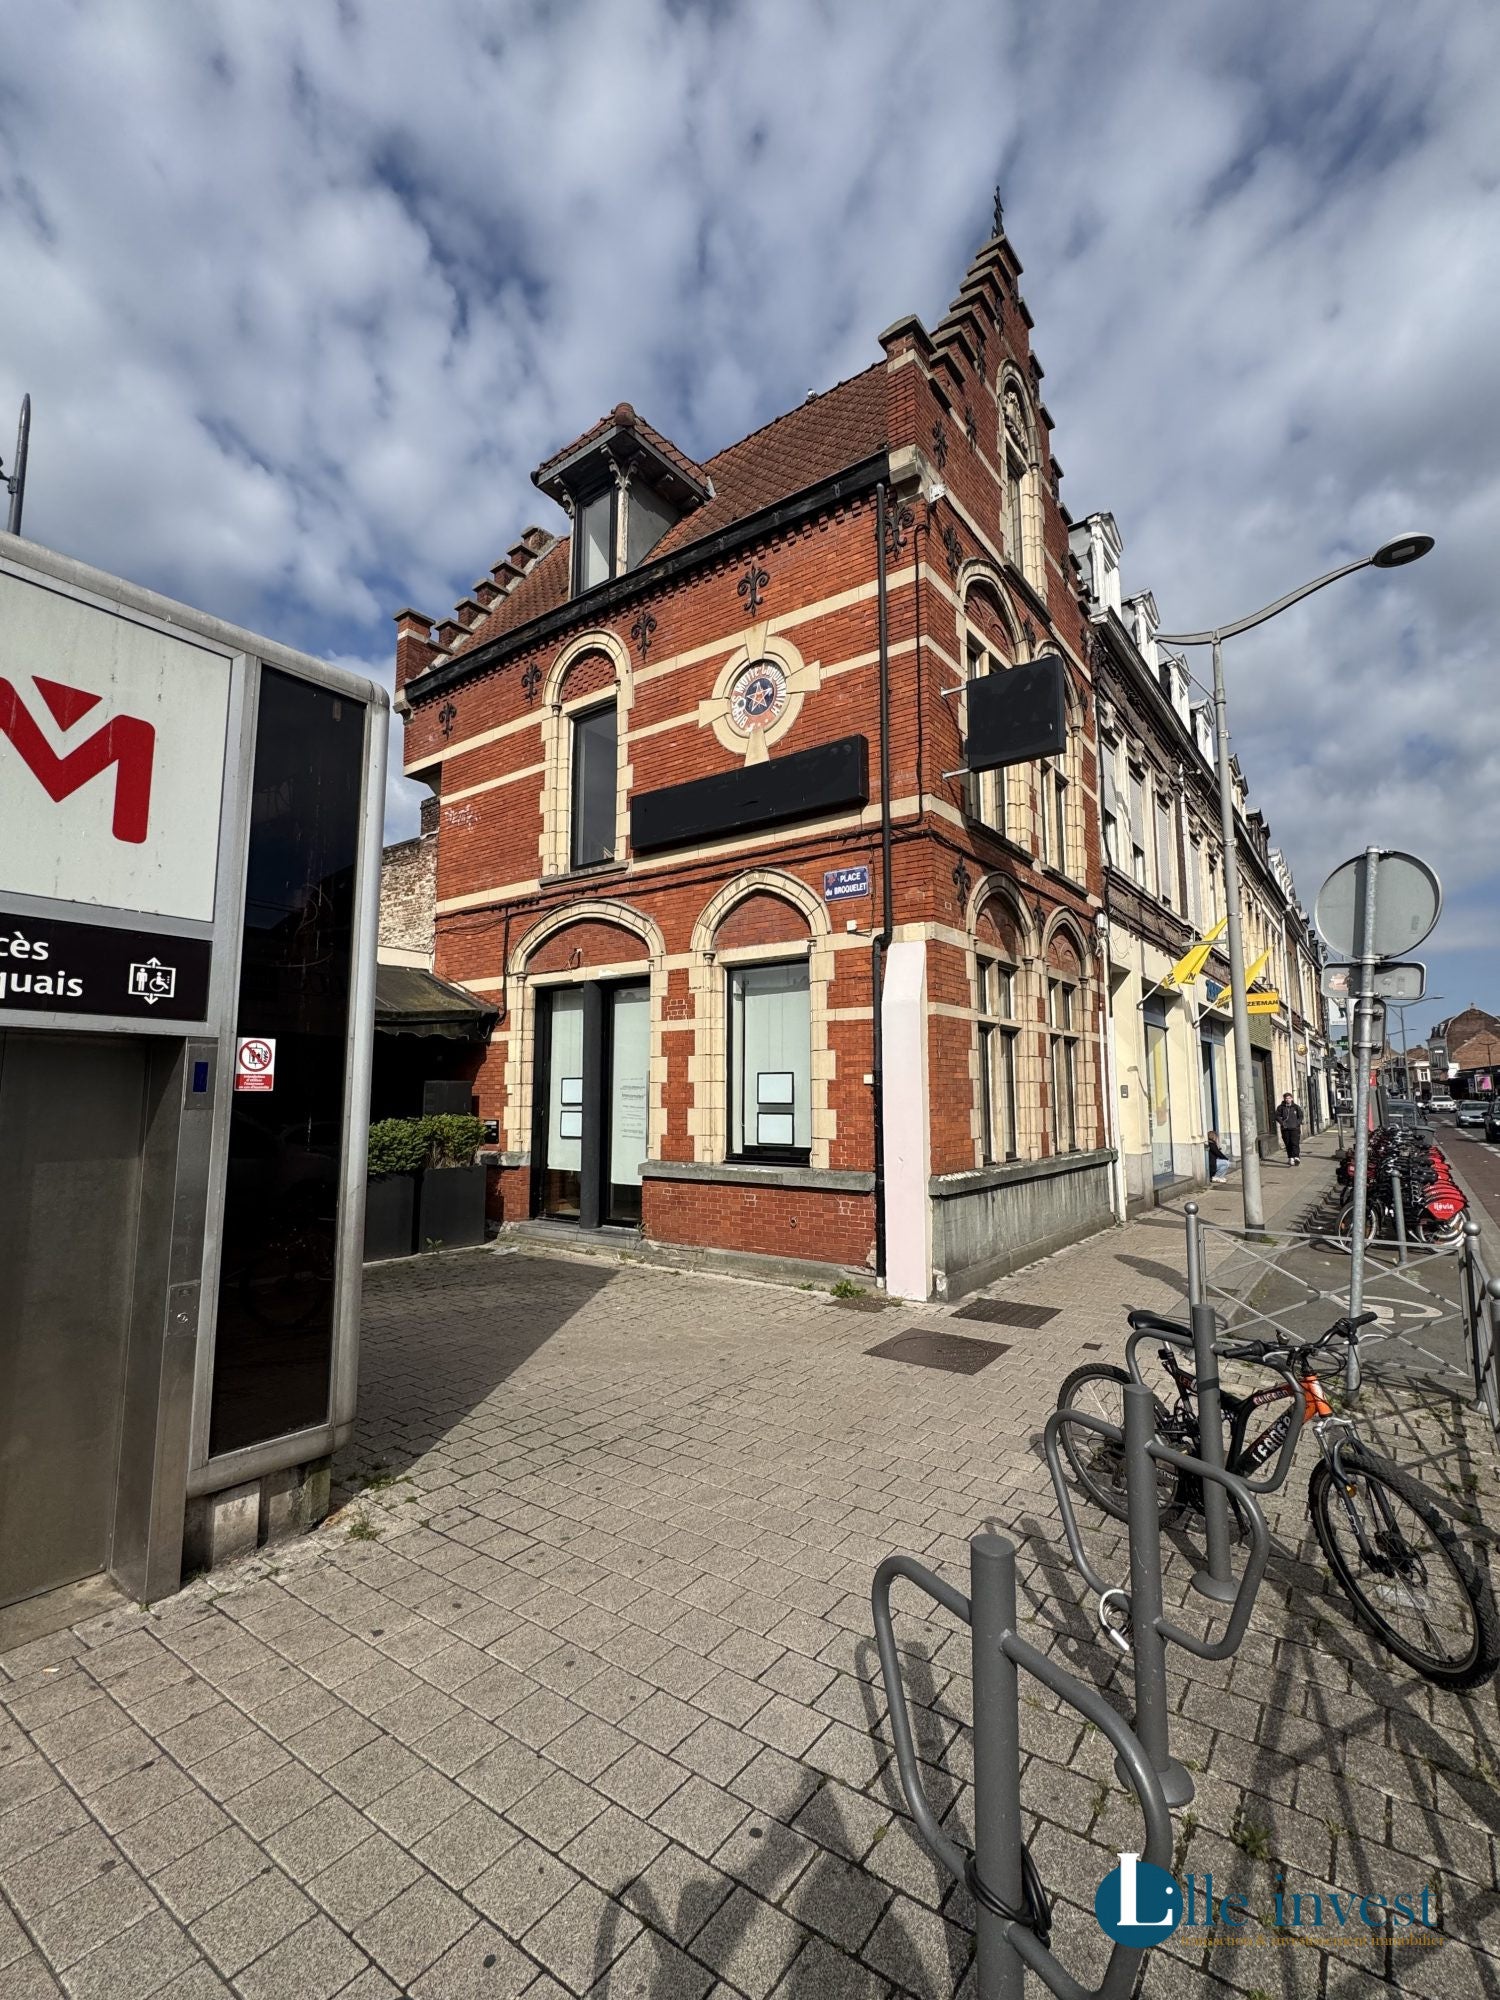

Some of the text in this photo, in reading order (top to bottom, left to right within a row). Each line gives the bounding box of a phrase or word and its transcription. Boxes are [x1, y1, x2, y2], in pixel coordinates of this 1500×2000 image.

[840, 872, 861, 883] PLACE
[826, 883, 867, 896] du BROQUELET
